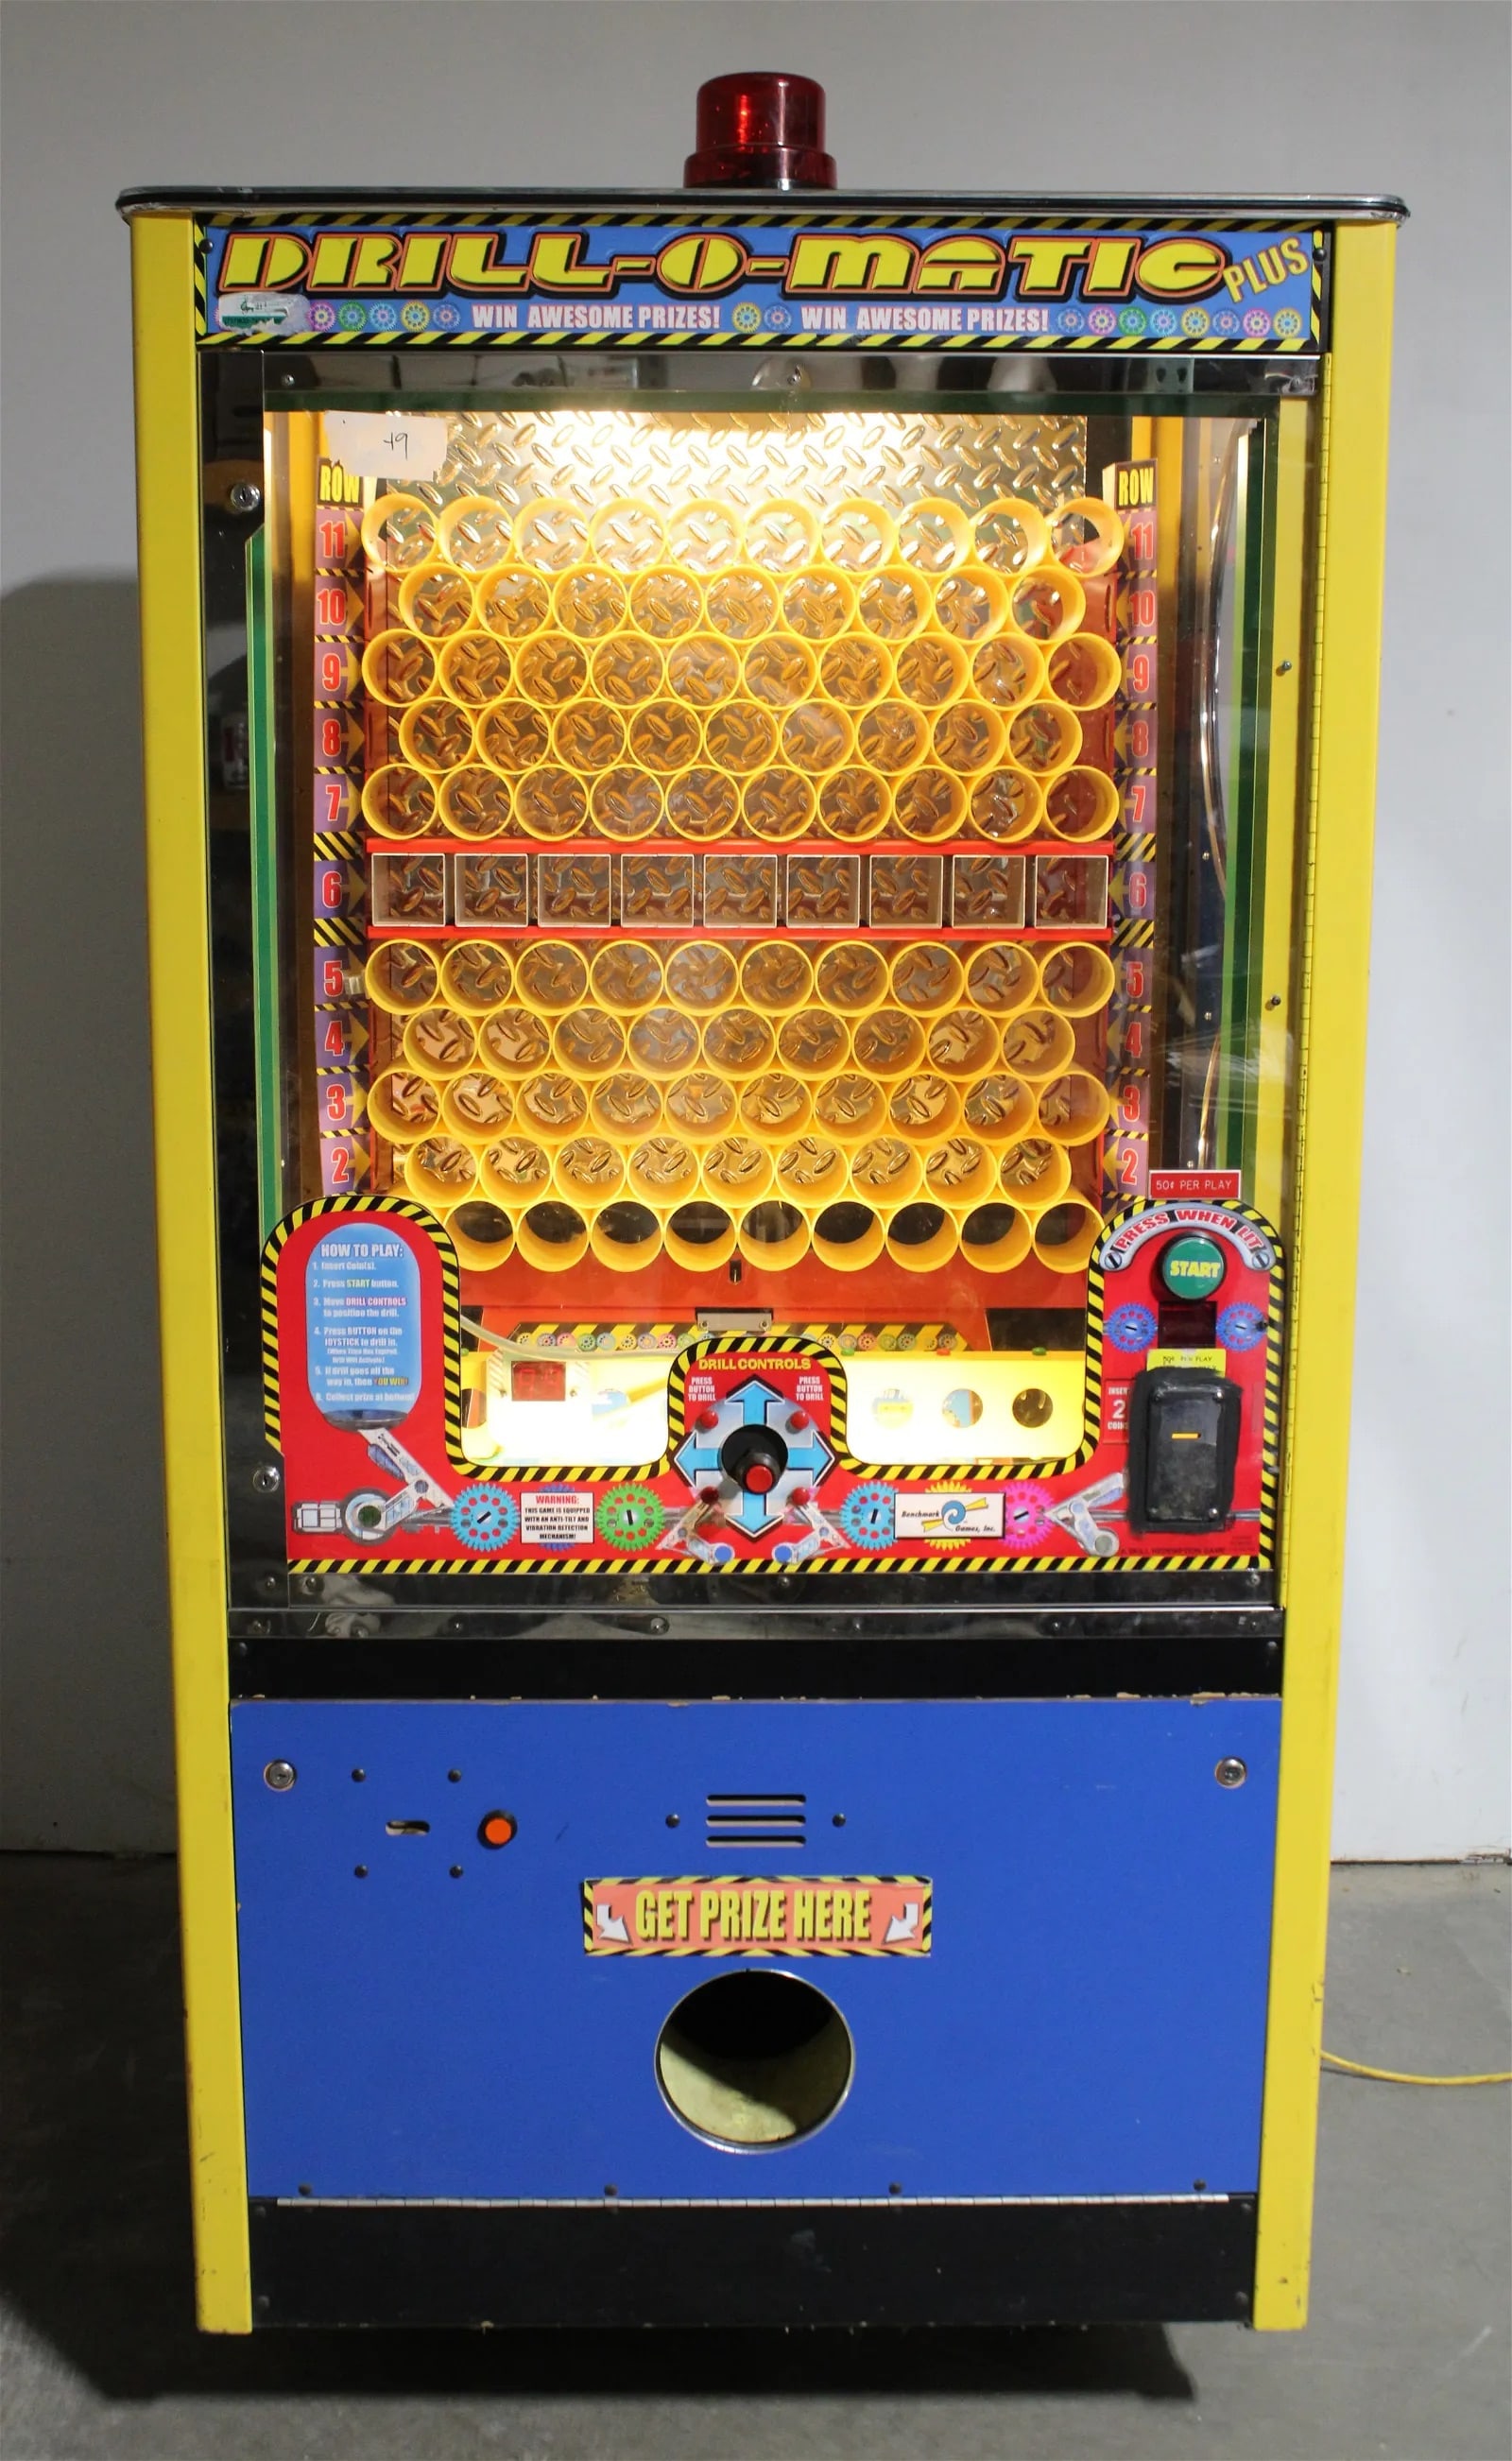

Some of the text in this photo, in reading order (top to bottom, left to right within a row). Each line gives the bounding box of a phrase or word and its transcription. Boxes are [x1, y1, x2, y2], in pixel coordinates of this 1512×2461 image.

[217, 232, 1308, 303] DRILL-O-MATIC PLUS
[472, 303, 720, 330] WIN AWESOME PRIZES!
[800, 306, 1048, 332] WIN AWESOME PRIZES!
[318, 464, 361, 504] ROW
[1118, 467, 1154, 506] ROW
[318, 521, 346, 559] 11
[1131, 522, 1154, 560] 11
[317, 589, 346, 626] 10
[1129, 590, 1156, 628] 10
[322, 653, 341, 691] 9
[1133, 654, 1150, 693] 9
[322, 718, 341, 756] 8
[1131, 720, 1149, 757] 8
[325, 784, 342, 821] 7
[1131, 785, 1145, 822] 7
[322, 870, 342, 908] 6
[1128, 872, 1146, 908] 6
[324, 960, 344, 997] 5
[1126, 961, 1144, 998] 5
[325, 1021, 344, 1056] 4
[1125, 1022, 1143, 1058] 4
[326, 1084, 347, 1121] 3
[1122, 1085, 1140, 1122] 3
[332, 1146, 350, 1183] 2
[1121, 1147, 1139, 1185] 2
[1179, 1179, 1200, 1191] PER
[1205, 1179, 1232, 1191] PLAY
[1113, 1209, 1264, 1251] PRESS WHEN LIT
[321, 1244, 404, 1258] HOW TO PLAY:
[1170, 1260, 1220, 1278] START
[313, 1279, 399, 1288] 2. Press START button.
[346, 1297, 367, 1306] DRILL
[368, 1297, 406, 1306] CONTROLS
[323, 1309, 332, 1317] to
[367, 1309, 379, 1317] the
[381, 1309, 399, 1317] drill.
[323, 1327, 346, 1335] Press
[348, 1327, 376, 1335] BUTTON
[389, 1327, 403, 1335] the
[325, 1338, 359, 1347] JOYSTICK
[369, 1338, 387, 1347] drill
[373, 1377, 388, 1385] YOU
[382, 1367, 394, 1375] the
[698, 1358, 812, 1370] DRILL CONTROLS
[799, 1376, 820, 1385] PRESS
[688, 1393, 716, 1402] TO DRILL
[689, 1385, 715, 1393] BUTTON
[796, 1385, 823, 1393] BUTTON
[796, 1393, 824, 1402] TO DRILL
[1112, 1399, 1125, 1419] 2
[536, 1495, 580, 1505] WARNING:
[635, 1890, 871, 1940] GET PRIZE HERE
